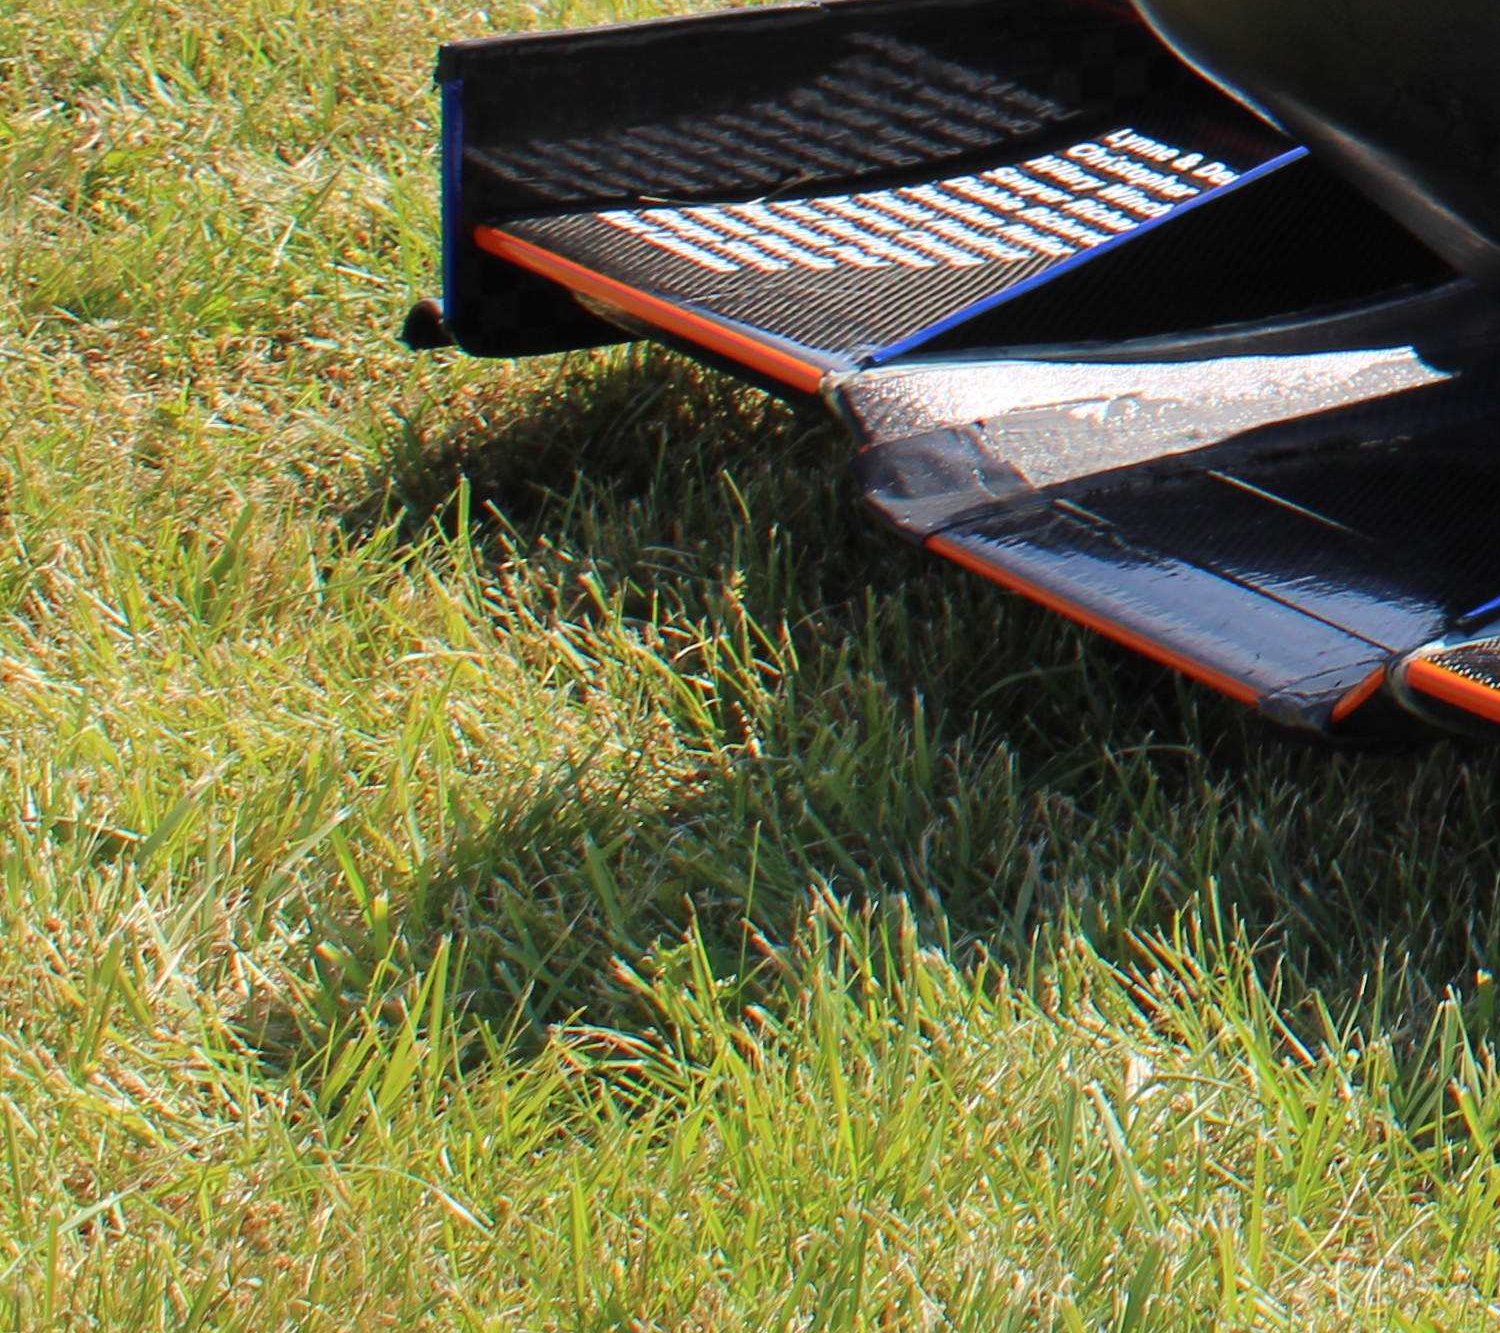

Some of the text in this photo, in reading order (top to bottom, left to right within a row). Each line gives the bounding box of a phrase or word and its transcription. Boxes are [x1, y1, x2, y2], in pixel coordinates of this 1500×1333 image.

[1066, 142, 1202, 198] Christopher
[1104, 128, 1181, 162] Lynne
[1170, 152, 1205, 172] &
[941, 175, 1026, 211] Debbie
[981, 166, 1075, 205] Sawyer
[1024, 154, 1175, 218] Hillary Winch
